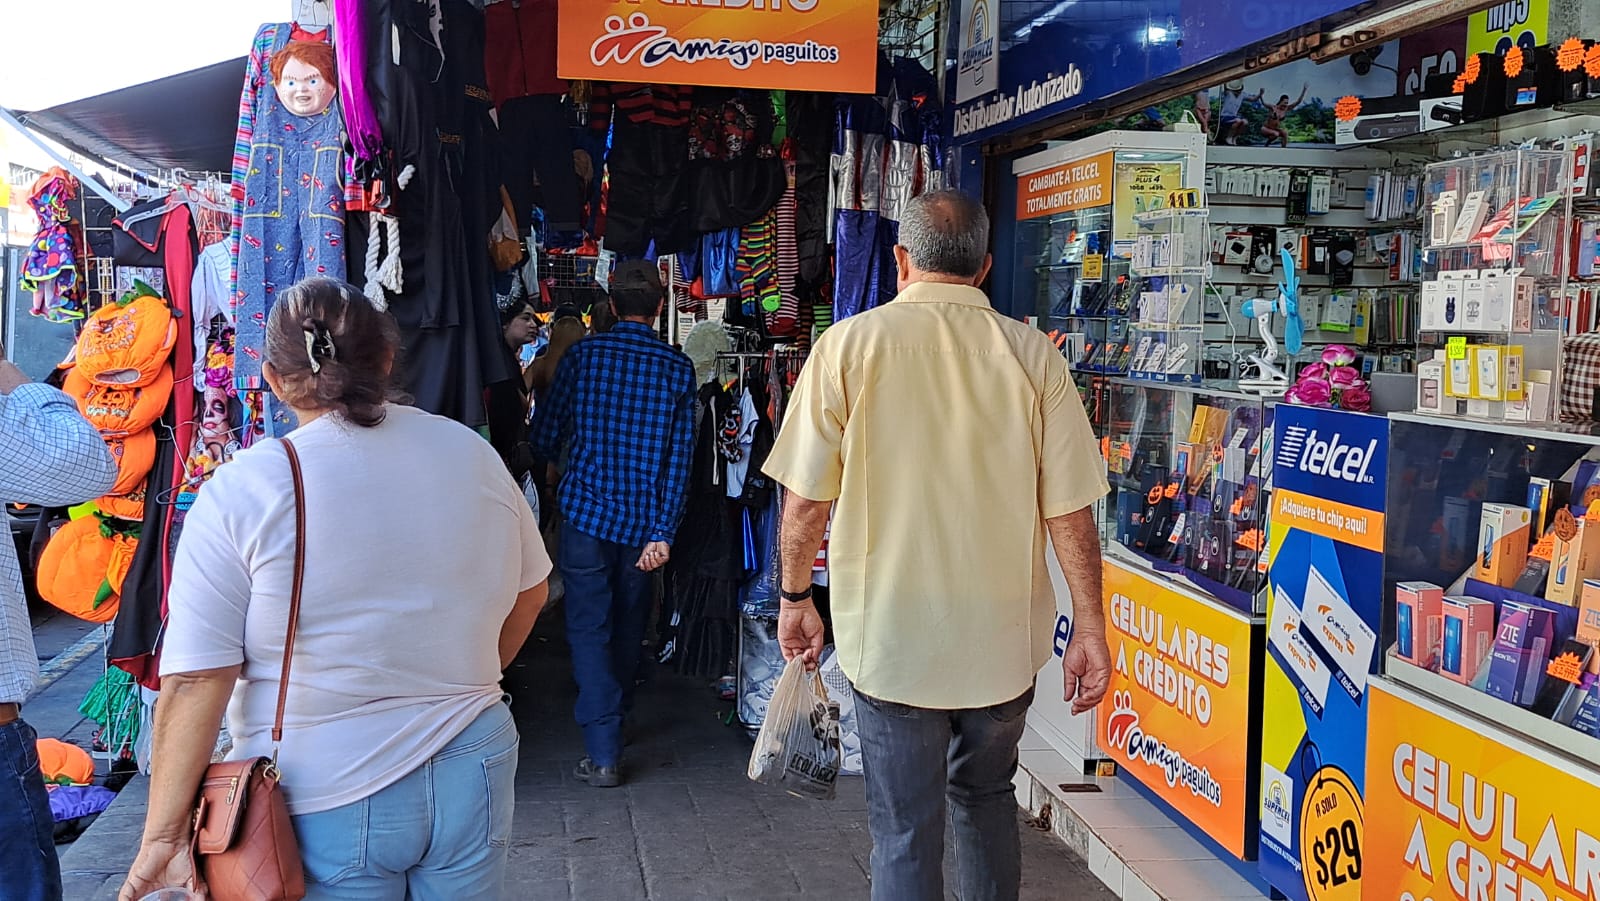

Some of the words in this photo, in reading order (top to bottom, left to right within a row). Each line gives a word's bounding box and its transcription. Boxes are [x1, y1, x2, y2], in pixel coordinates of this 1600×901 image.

[643, 38, 758, 66] amigo
[764, 41, 838, 63] paguitos
[953, 94, 1015, 138] Distribuidor
[1015, 63, 1082, 118] Autorizado
[1028, 171, 1065, 193] CAMBIATE
[1064, 172, 1071, 184] A
[1071, 162, 1100, 182] TELCEL
[1026, 191, 1072, 214] TOTALMENTE
[1073, 184, 1102, 206] GRATIS
[1299, 429, 1378, 483] telcel
[1280, 497, 1316, 520] ¡Adquiere
[1317, 507, 1326, 524] tu
[1327, 511, 1344, 531] chip
[1110, 593, 1229, 687] CELULARES
[1322, 625, 1344, 654] express
[1501, 623, 1520, 644] ZTE
[1115, 639, 1129, 679] A
[1134, 649, 1212, 726] CRÉDITO
[1340, 676, 1359, 699] telcel
[1303, 690, 1321, 713] telcel
[1128, 731, 1179, 783] amigo
[1181, 761, 1221, 805] paguitos
[1315, 802, 1321, 818] A
[1321, 792, 1338, 815] SOLO
[1312, 819, 1362, 891] $29
[1403, 814, 1434, 884] A
